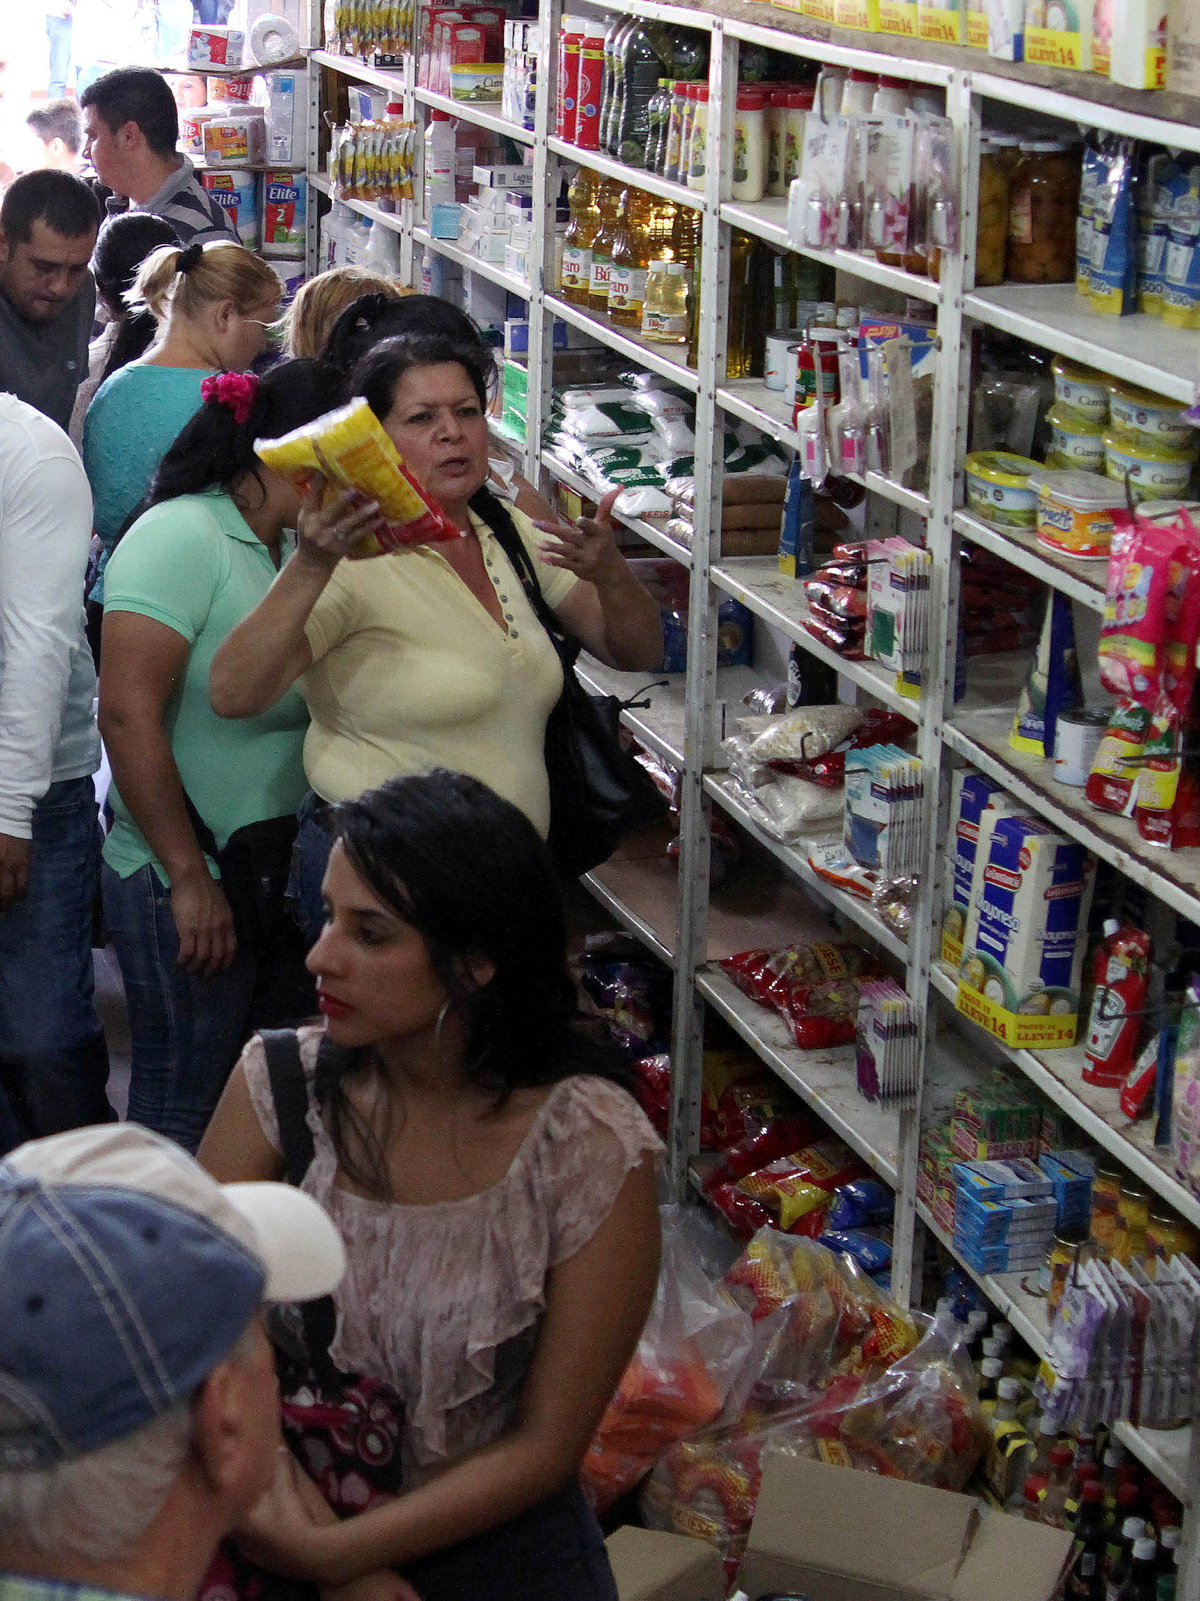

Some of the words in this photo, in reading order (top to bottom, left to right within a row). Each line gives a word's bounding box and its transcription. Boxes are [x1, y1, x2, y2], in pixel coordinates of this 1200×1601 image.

[1059, 47, 1075, 65] 14
[269, 186, 297, 200] Elite
[276, 208, 285, 222] 2
[562, 260, 580, 274] caro
[609, 280, 629, 294] caro
[959, 999, 989, 1028] LLEVE
[992, 1017, 1007, 1040] 14
[1017, 1032, 1055, 1041] LLEVE
[1058, 1028, 1073, 1041] 14
